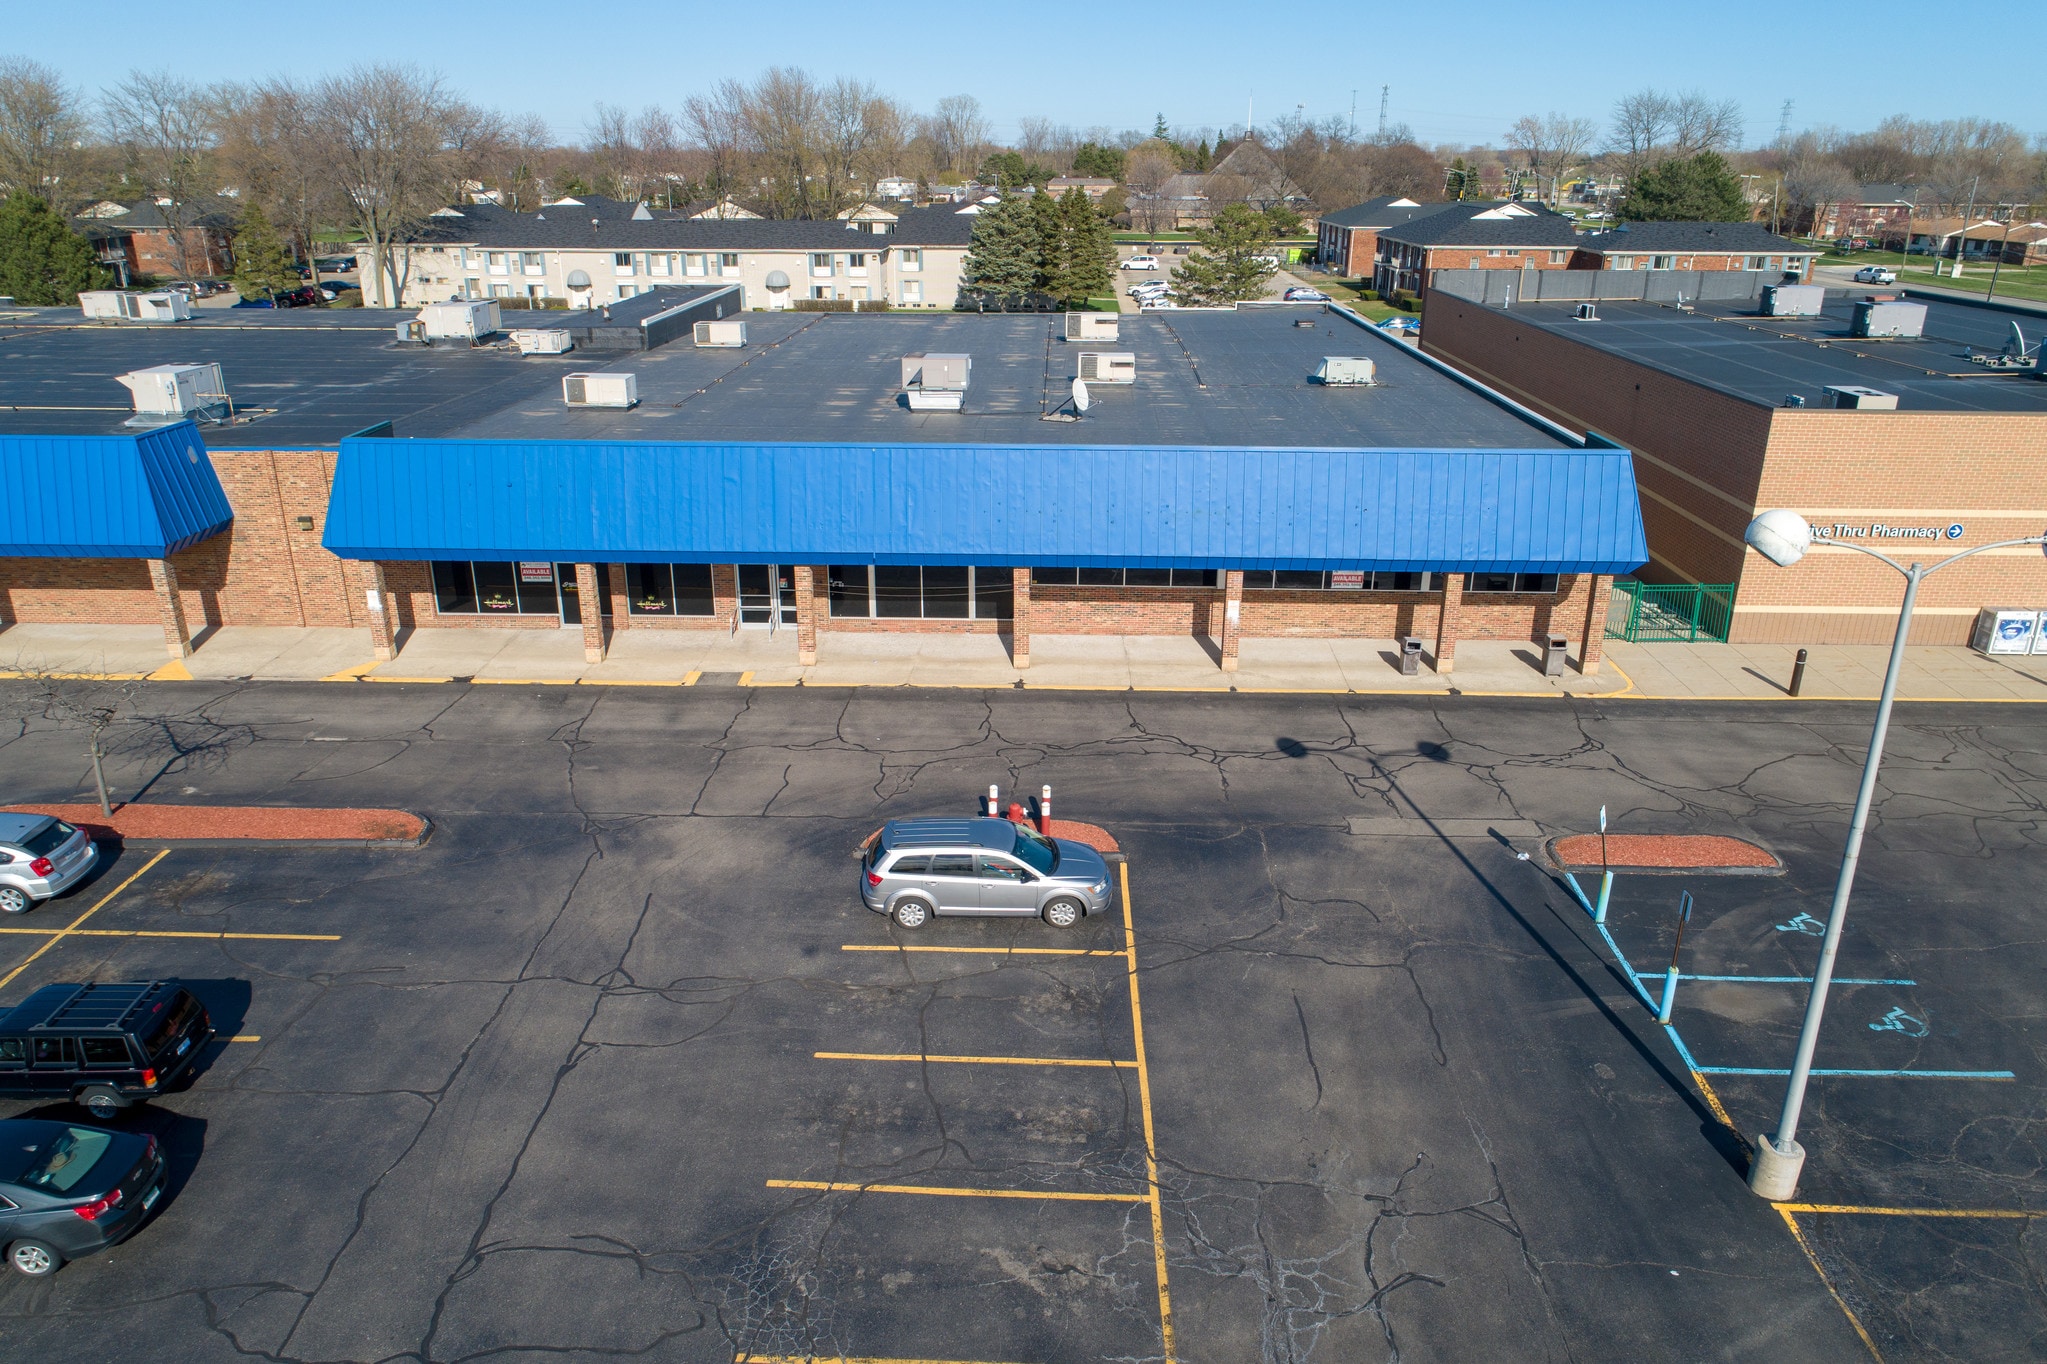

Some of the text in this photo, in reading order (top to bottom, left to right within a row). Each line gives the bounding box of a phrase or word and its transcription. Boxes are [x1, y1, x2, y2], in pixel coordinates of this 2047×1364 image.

[1808, 523, 1944, 540] ive Thru Pharmacy
